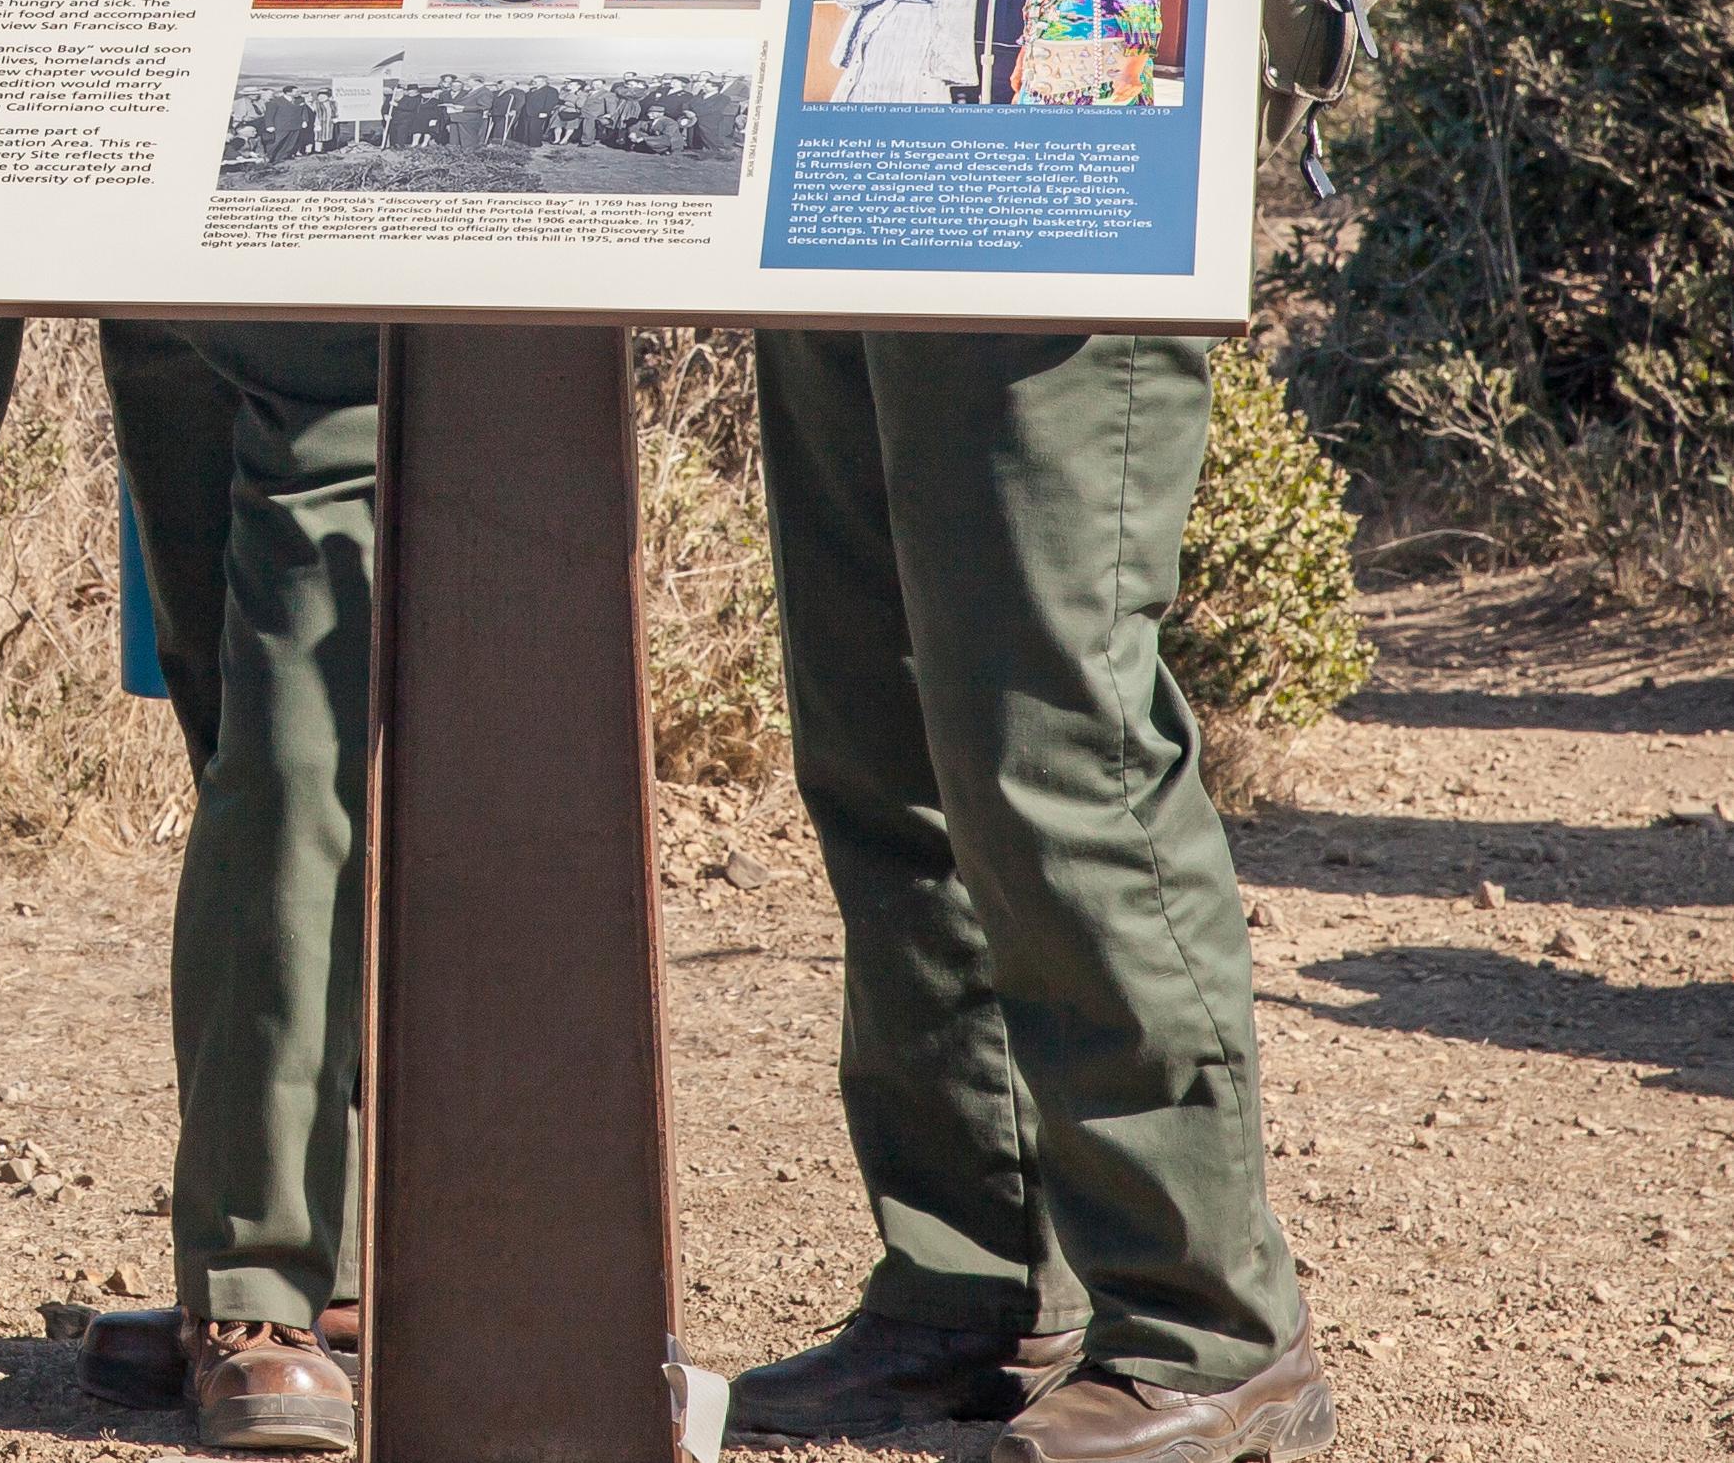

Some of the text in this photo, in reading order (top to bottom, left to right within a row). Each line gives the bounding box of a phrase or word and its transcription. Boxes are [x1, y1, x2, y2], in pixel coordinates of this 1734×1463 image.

[367, 12, 418, 20] postcards
[797, 138, 1136, 152] Jakki Kehl is Mutsun Ohlone. Her fourth great
